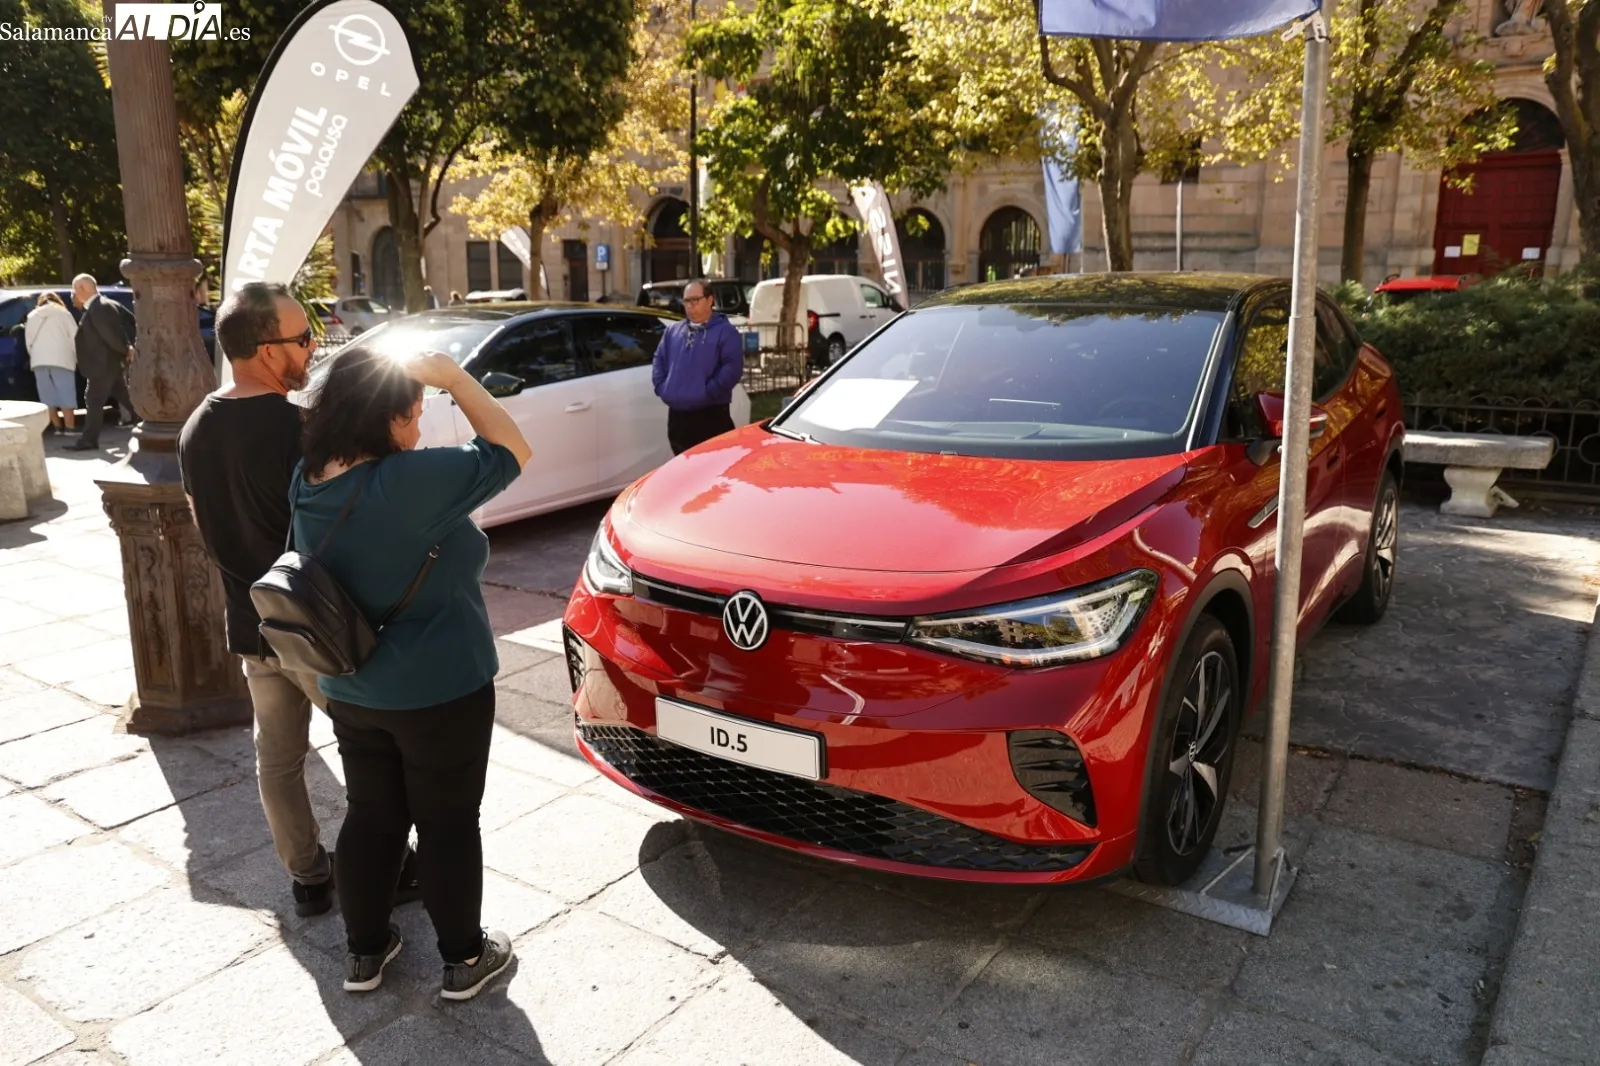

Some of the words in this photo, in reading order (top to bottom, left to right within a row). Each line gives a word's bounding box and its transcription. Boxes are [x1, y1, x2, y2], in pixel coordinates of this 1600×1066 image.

[310, 61, 392, 98] OPEL
[262, 106, 328, 212] MÓVIL
[305, 114, 348, 198] palausa
[597, 245, 607, 261] P
[710, 726, 748, 752] ID.5
